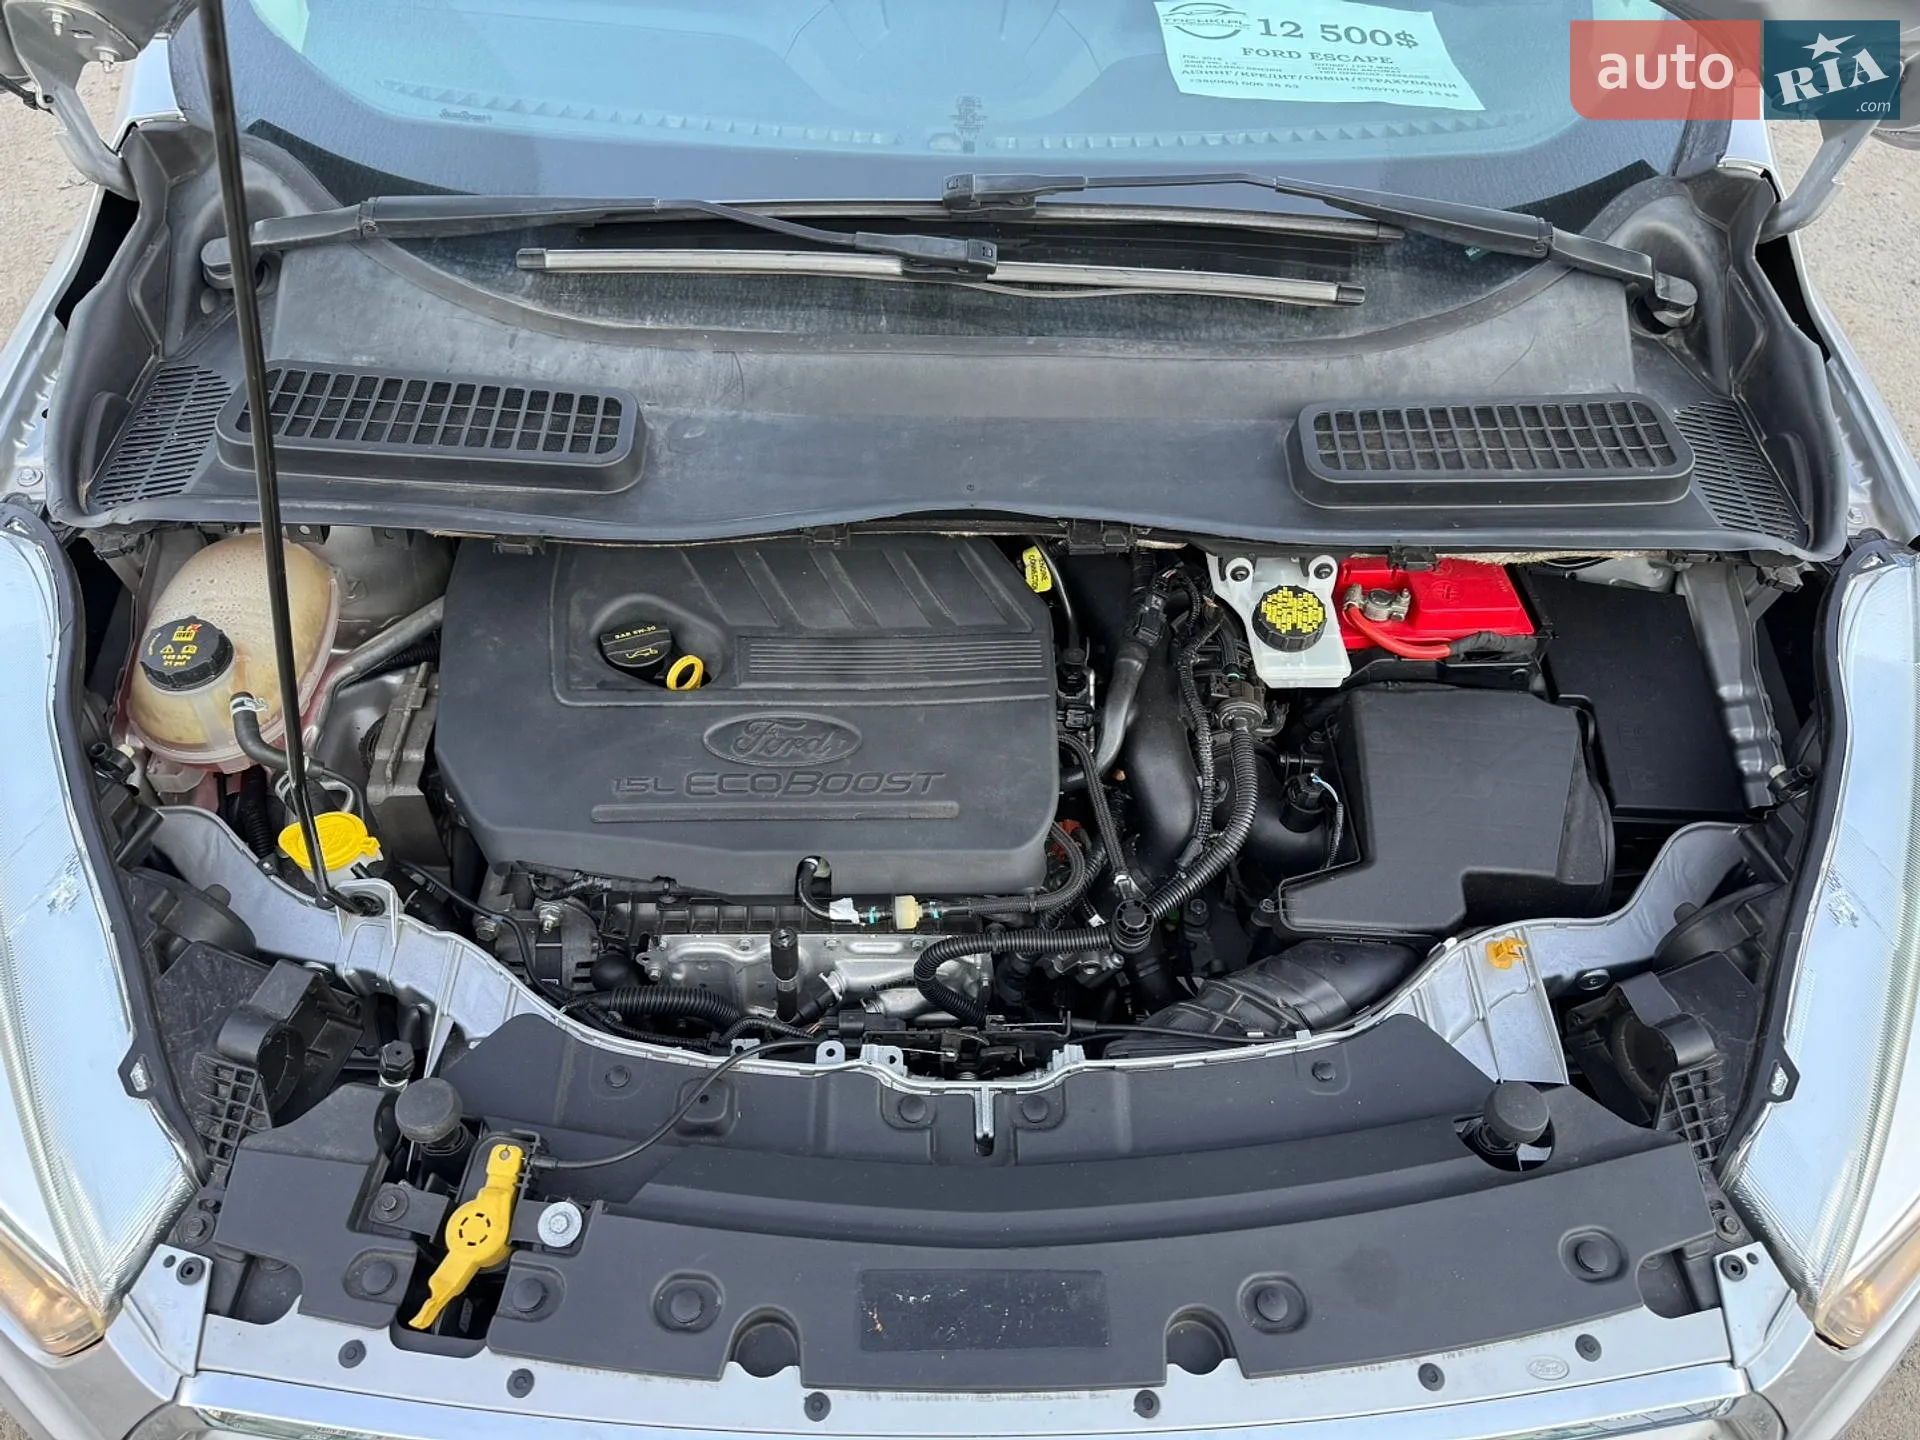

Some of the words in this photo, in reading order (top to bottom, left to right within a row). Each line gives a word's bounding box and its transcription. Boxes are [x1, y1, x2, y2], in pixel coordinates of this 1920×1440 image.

[1257, 18, 1304, 39] 12
[1320, 23, 1419, 49] 500$
[1241, 46, 1302, 60] FORD
[1309, 51, 1394, 64] ESCAPE
[731, 718, 841, 758] Ford
